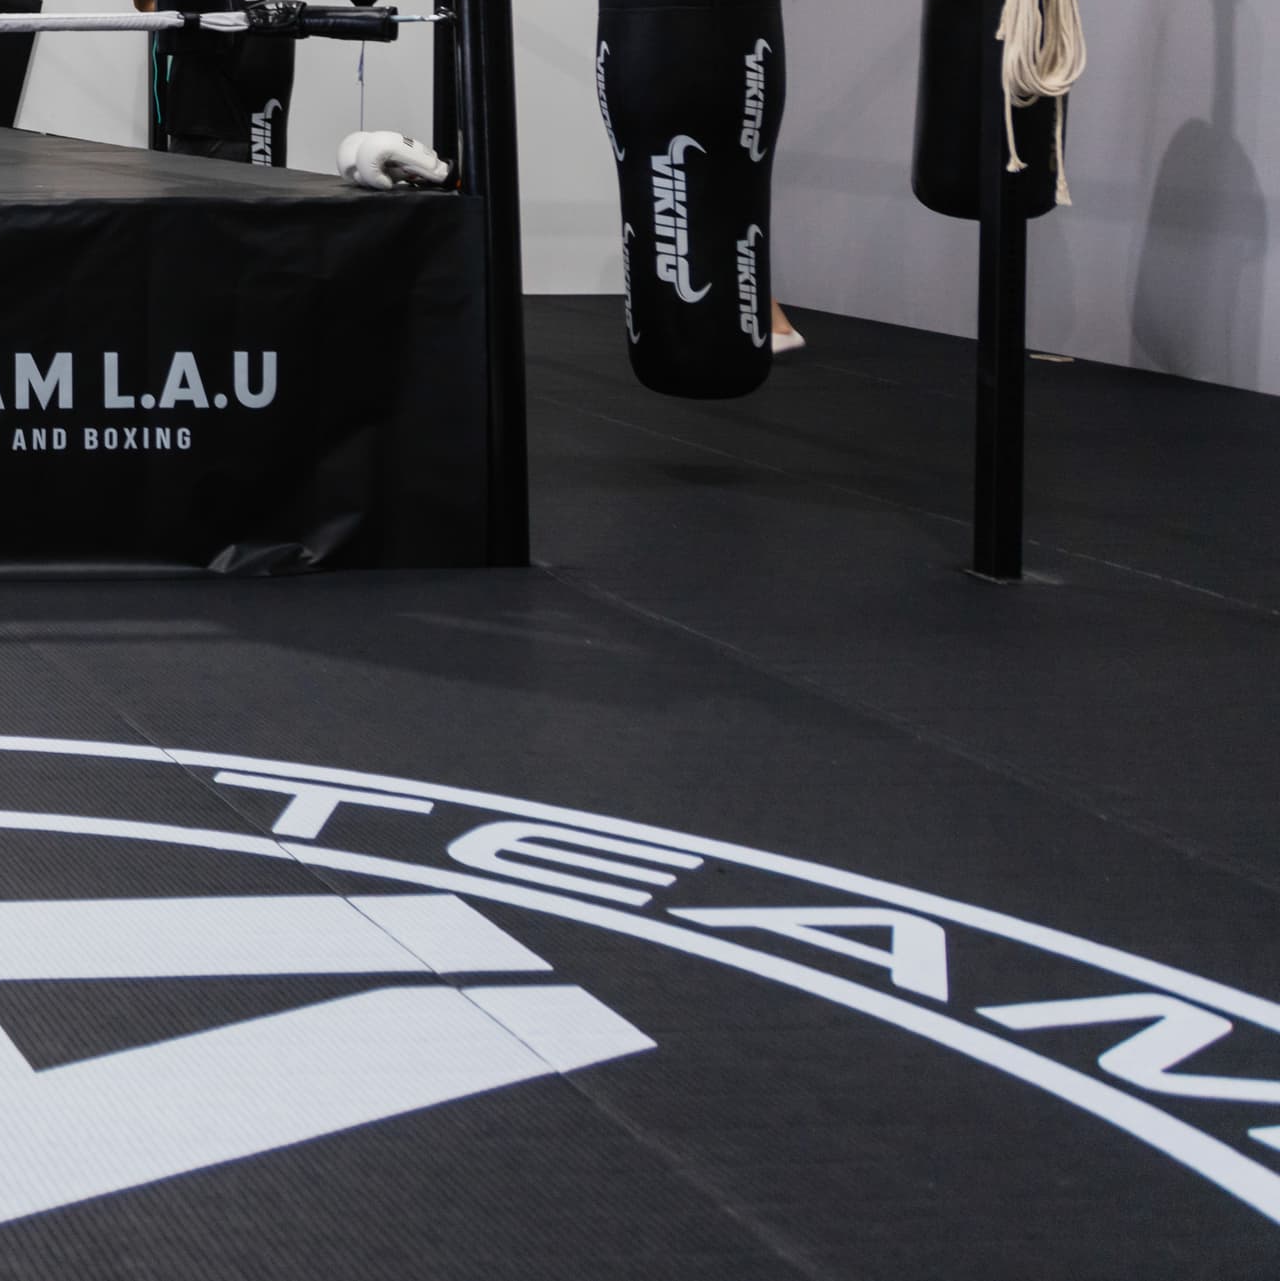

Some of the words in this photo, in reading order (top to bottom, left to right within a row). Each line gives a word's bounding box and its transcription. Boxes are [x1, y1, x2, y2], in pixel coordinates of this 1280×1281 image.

[251, 98, 283, 167] VIKI
[740, 38, 773, 162] VIKING
[650, 134, 713, 303] VIKING
[736, 223, 768, 348] VIKING
[104, 351, 278, 409] L.A.U
[12, 428, 68, 450] AND
[84, 427, 192, 450] BOXING
